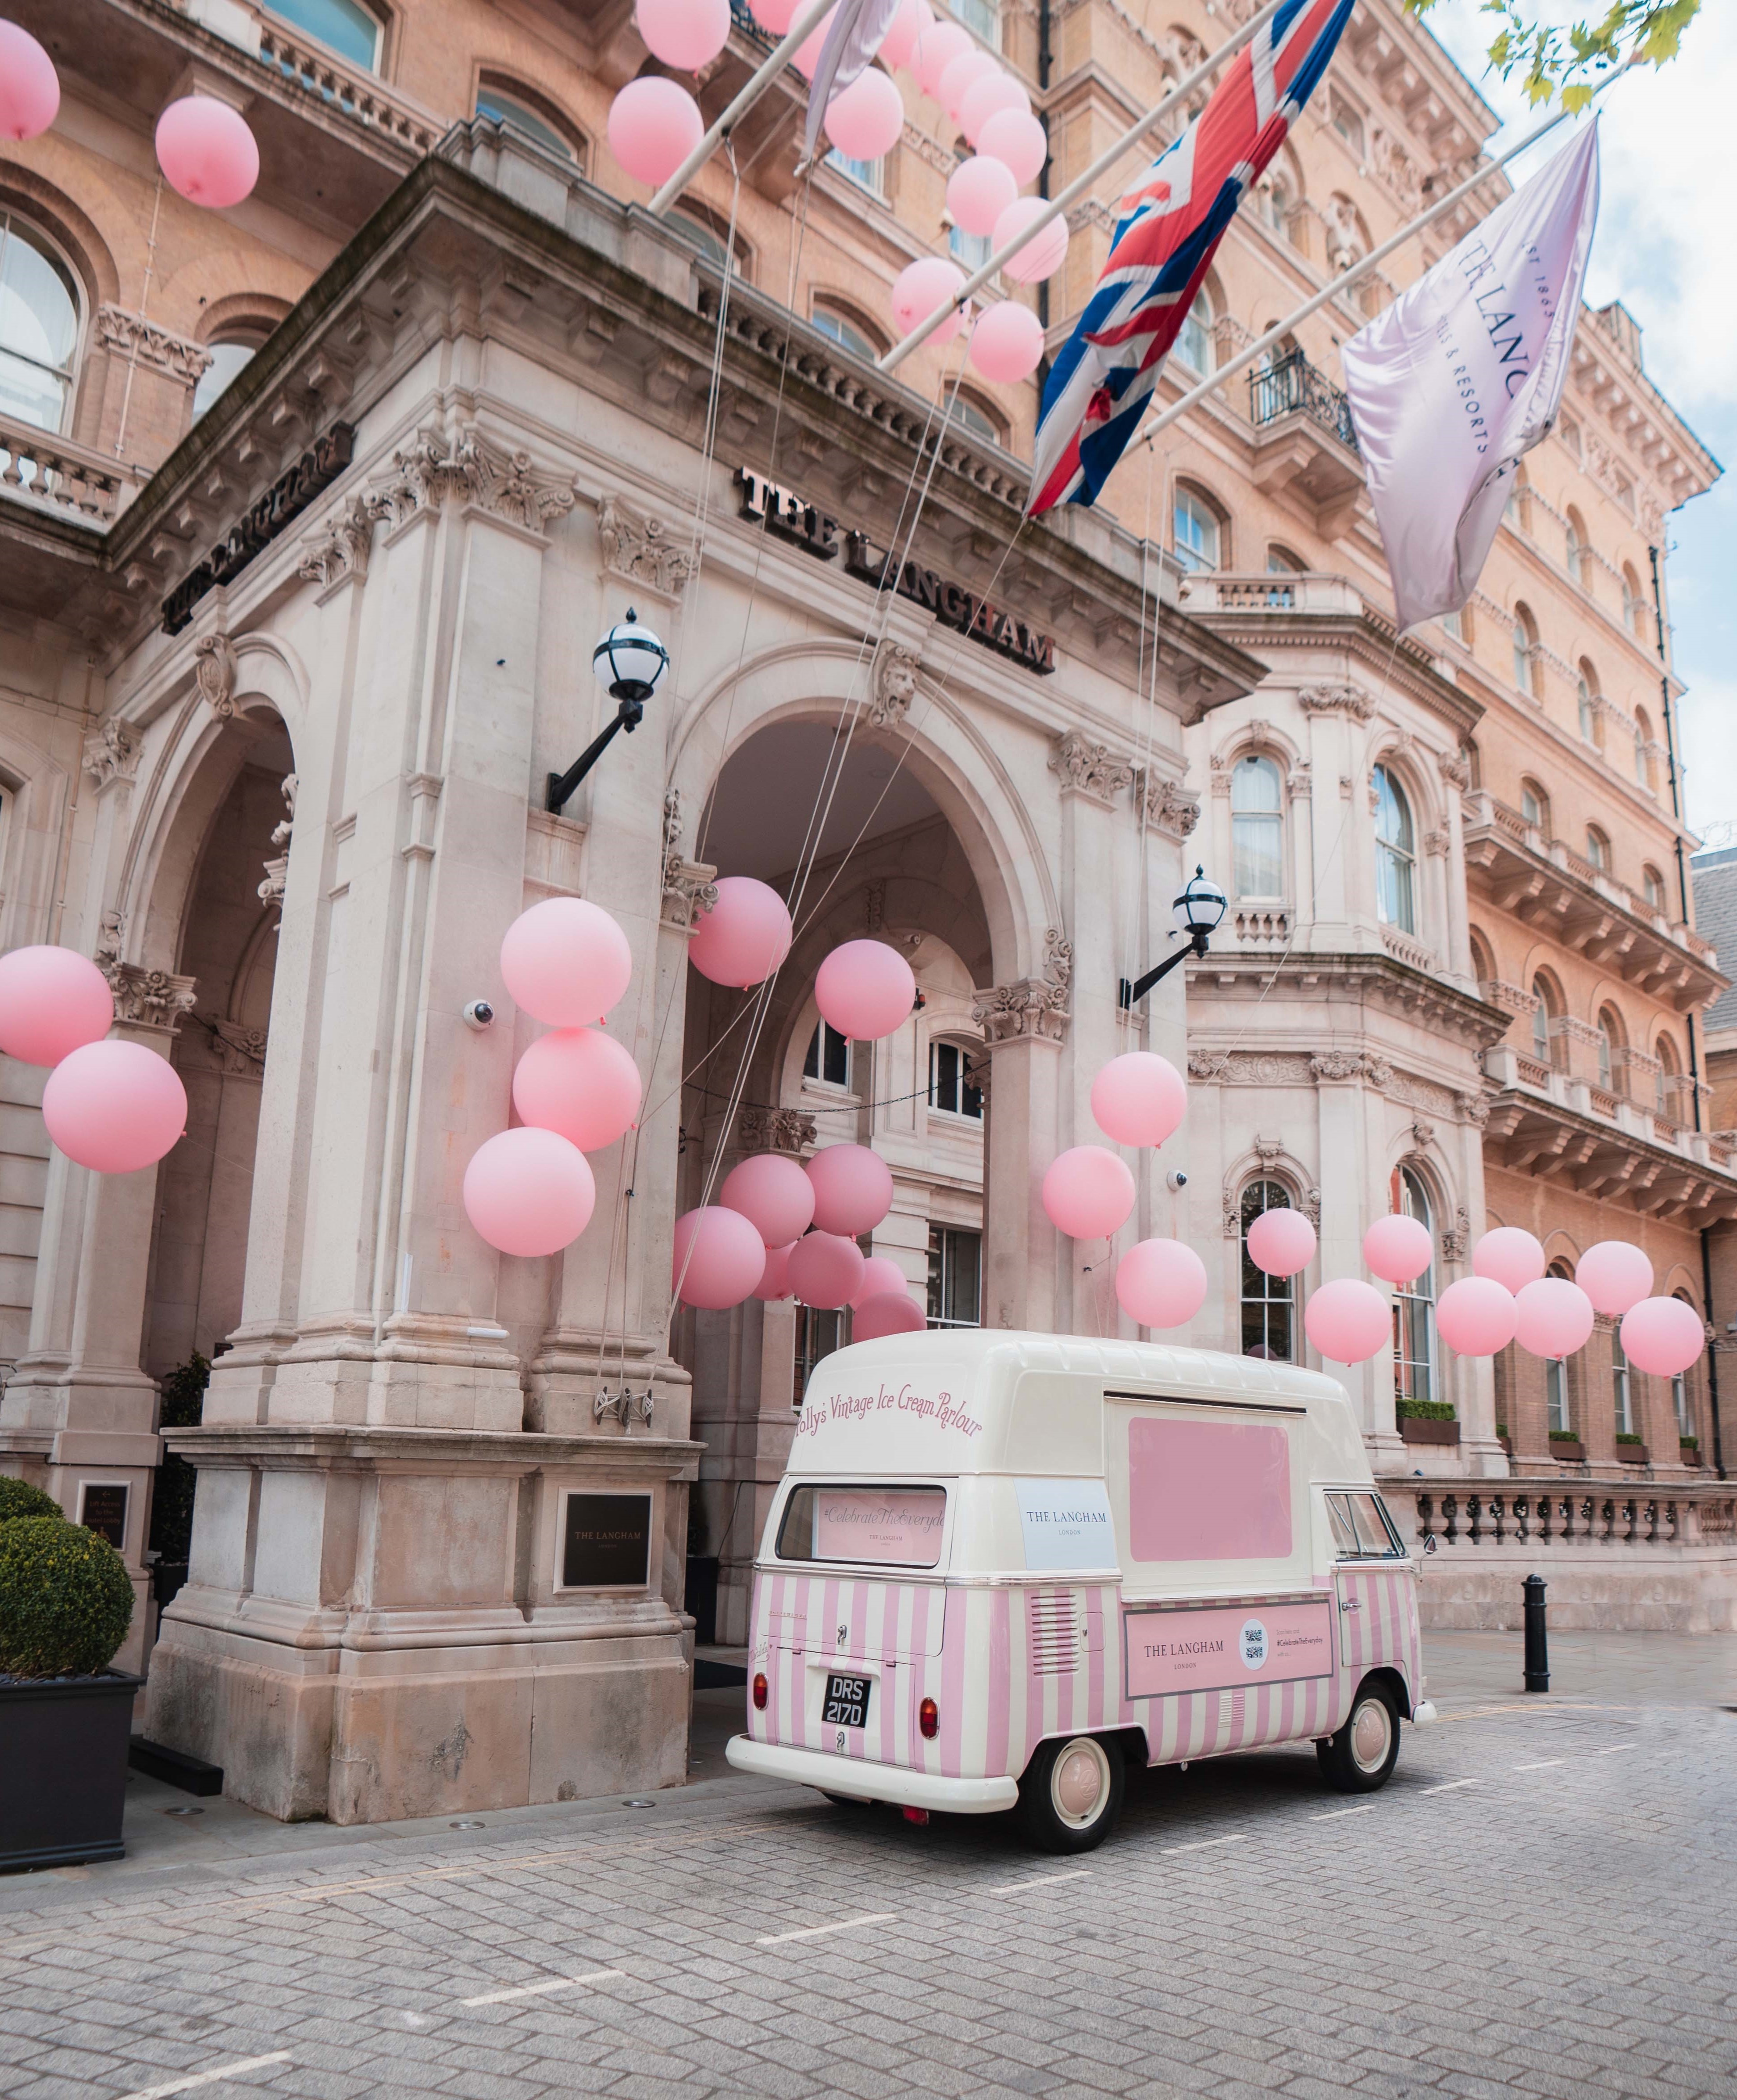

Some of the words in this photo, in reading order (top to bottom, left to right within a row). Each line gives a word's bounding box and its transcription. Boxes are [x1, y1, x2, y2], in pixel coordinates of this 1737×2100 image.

[1454, 365, 1490, 454] RESORTS
[735, 466, 839, 560] THE
[845, 529, 1056, 675] LANGHAM
[830, 1394, 873, 1420] Vintage
[877, 1384, 894, 1409] Ice
[898, 1384, 934, 1418] Cream
[935, 1392, 982, 1437] Parlour
[1027, 1512, 1050, 1522] THE
[1053, 1512, 1107, 1522] LANGHAM
[575, 1532, 594, 1540] THE
[596, 1532, 641, 1540] LANGHAM
[1144, 1644, 1167, 1658] THE
[1171, 1640, 1224, 1656] LANGHAM
[1277, 1636, 1323, 1647] #CelebrateTheEveryday
[832, 1678, 864, 1701] DRS
[827, 1701, 862, 1725] 217D
